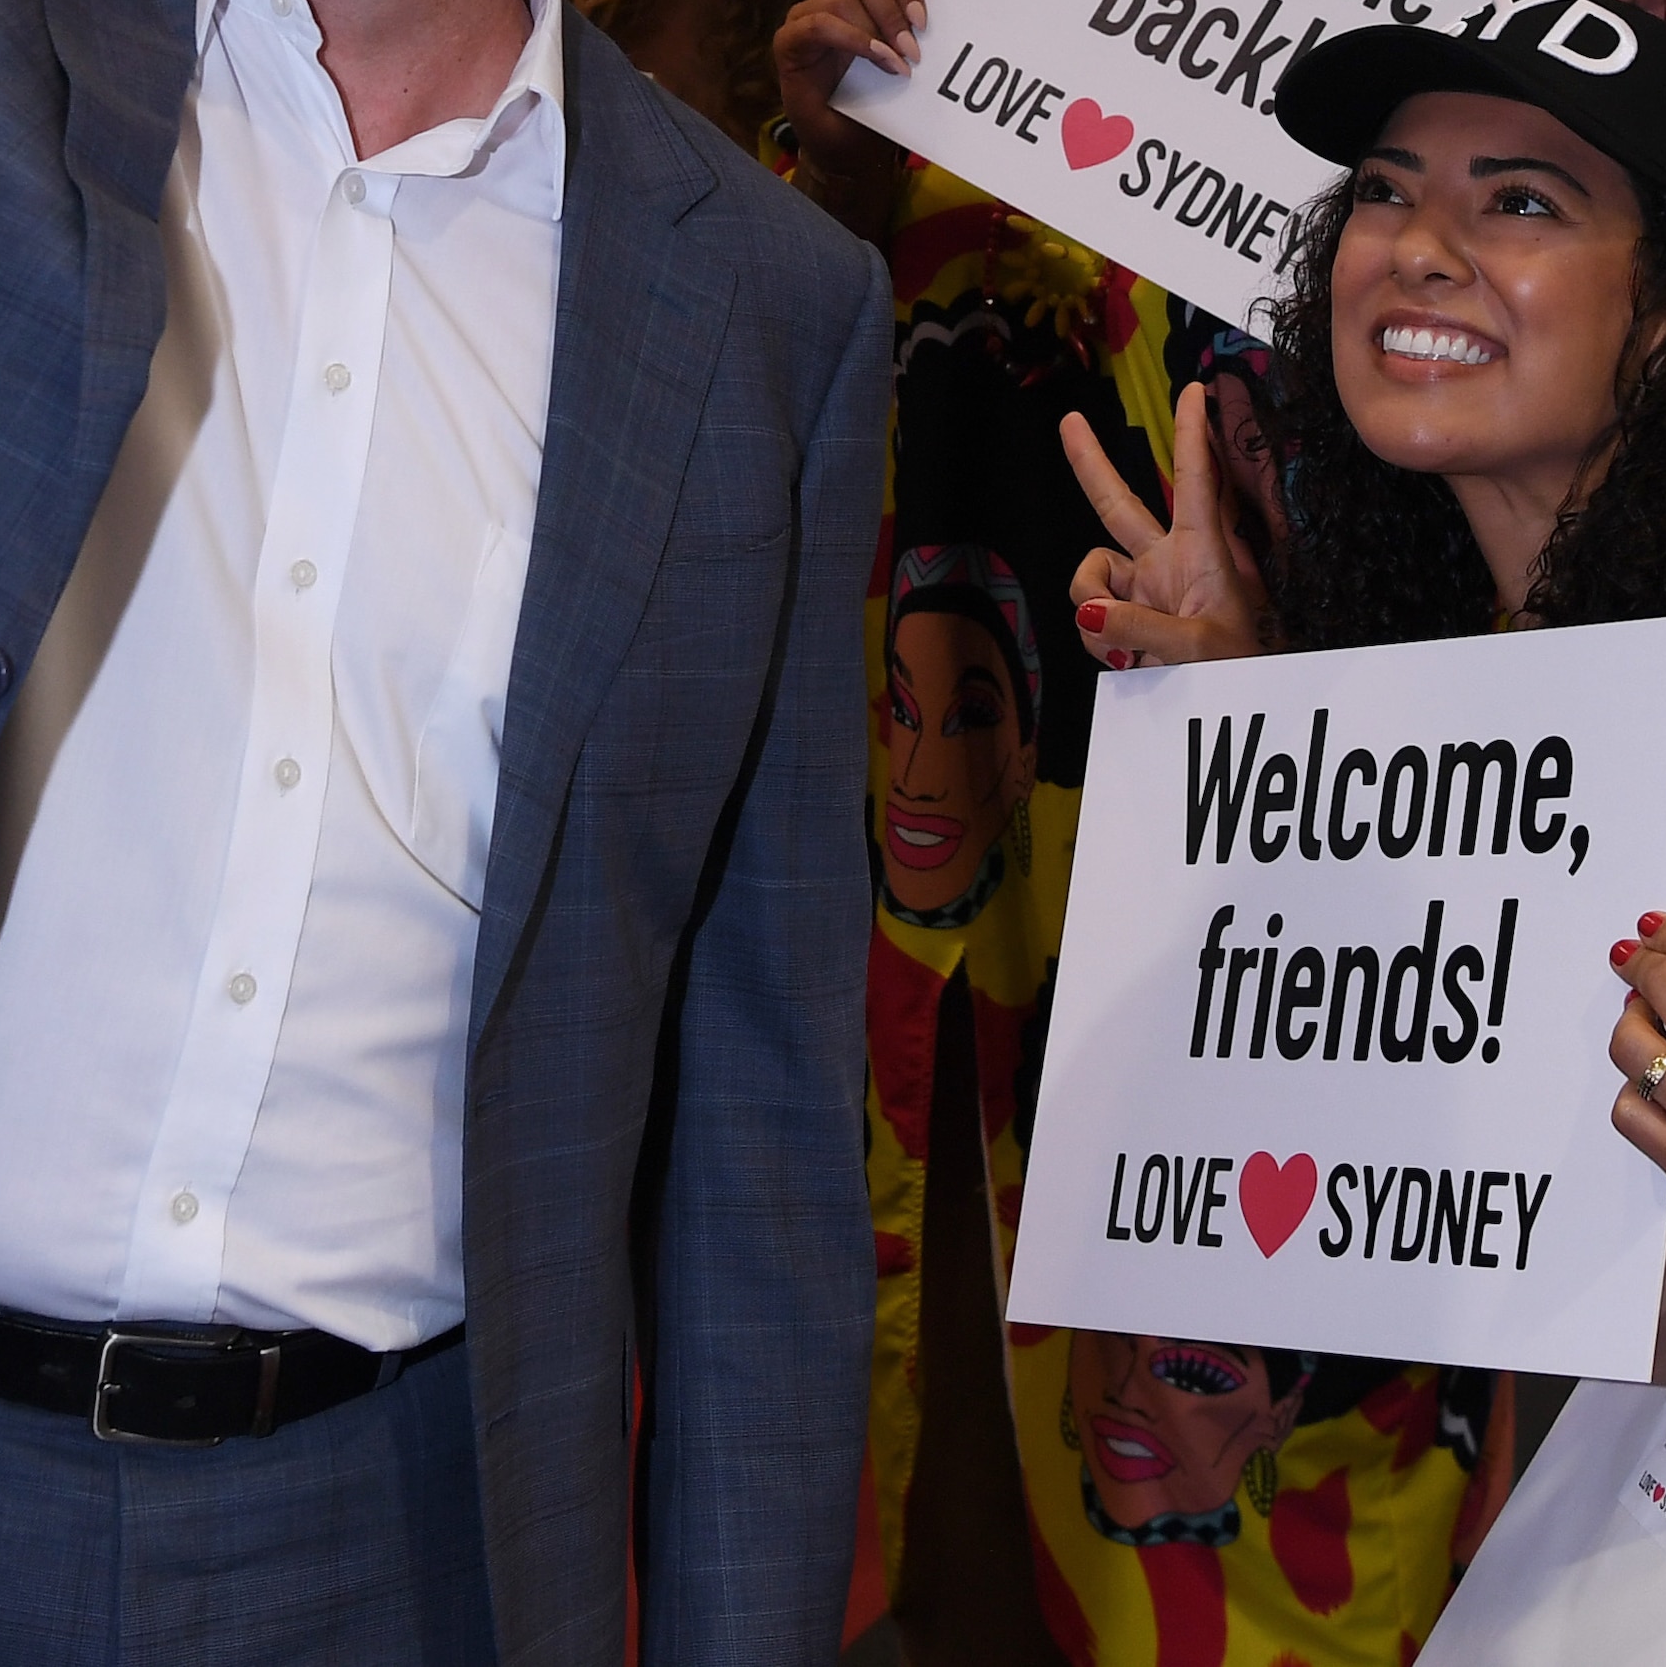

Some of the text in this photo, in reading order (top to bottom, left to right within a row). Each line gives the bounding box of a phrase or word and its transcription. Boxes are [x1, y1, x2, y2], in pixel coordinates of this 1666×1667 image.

[936, 42, 1066, 145] LOVE
[1185, 708, 1590, 877] Welcome,
[1189, 898, 1519, 1064] friends!
[1106, 1152, 1552, 1271] LOVE SYDNEY
[1639, 1470, 1655, 1498] LOVE
